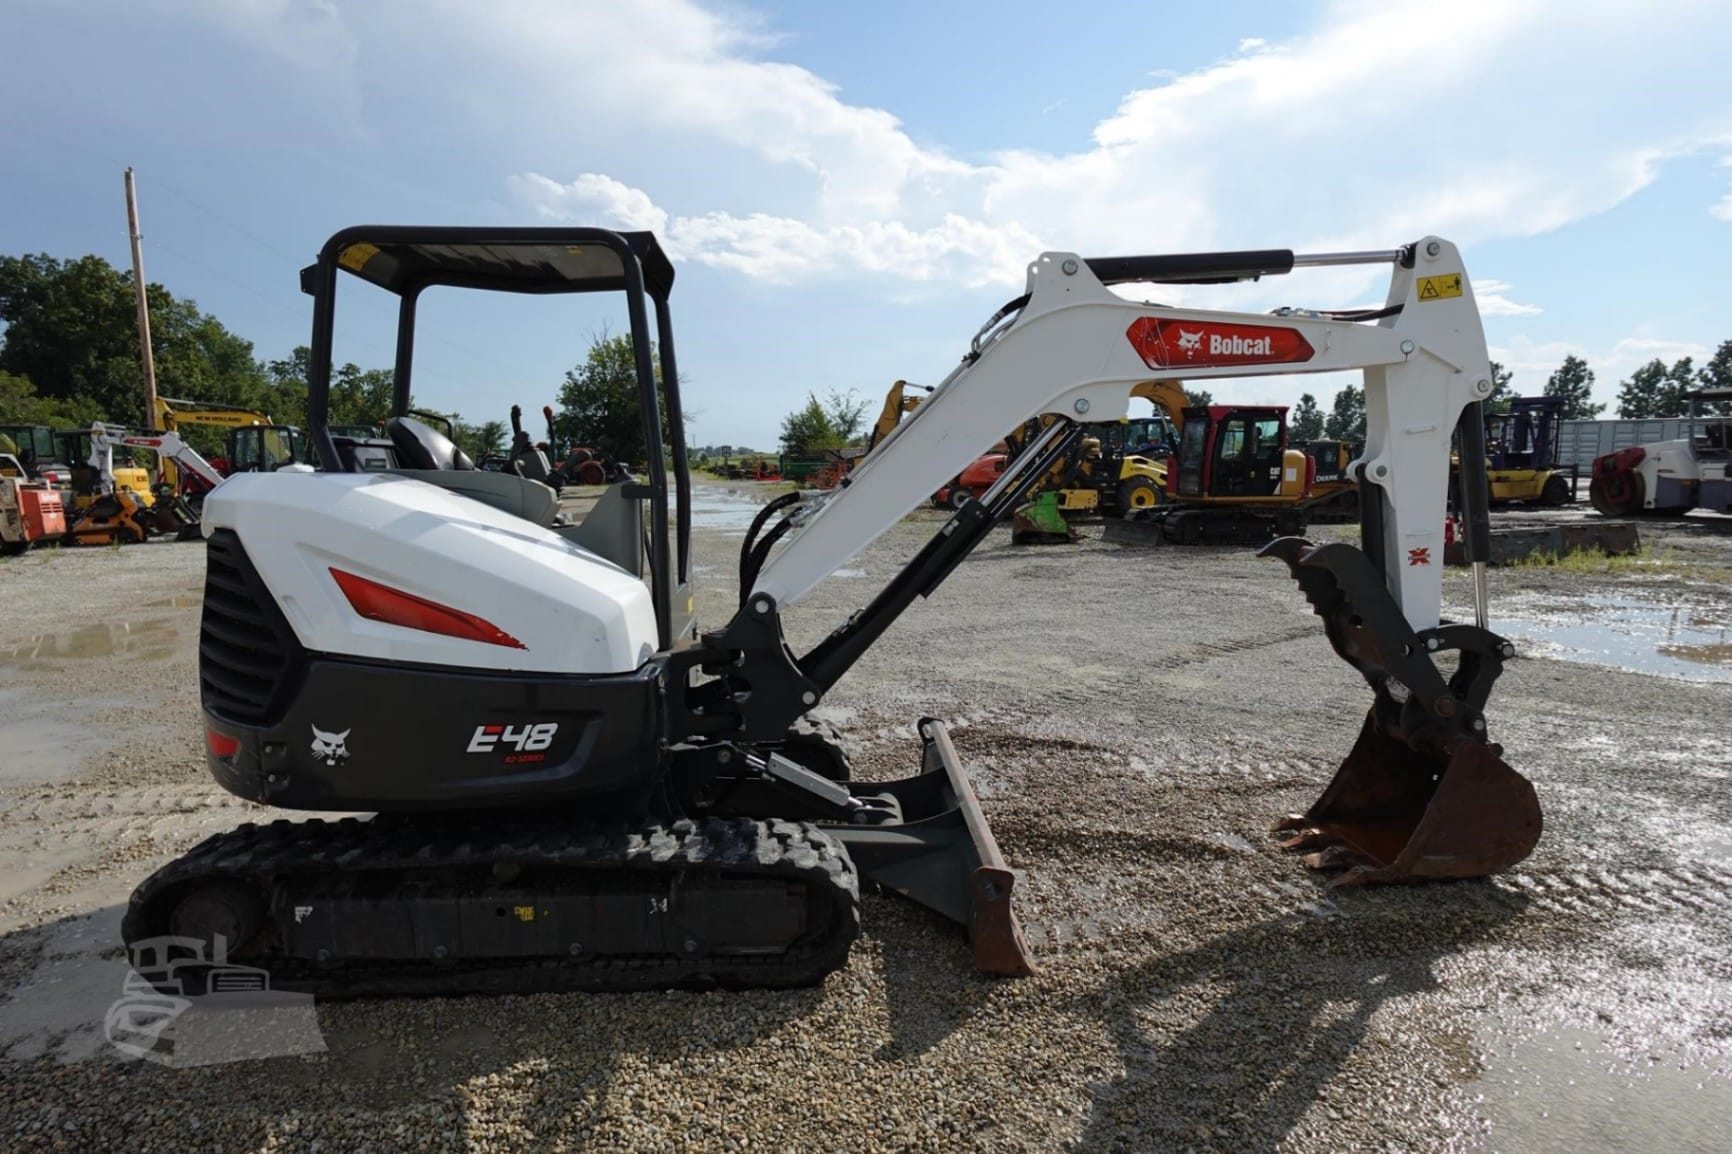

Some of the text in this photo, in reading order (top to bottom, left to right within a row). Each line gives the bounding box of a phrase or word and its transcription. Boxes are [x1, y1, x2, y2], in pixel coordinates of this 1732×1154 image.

[1210, 333, 1271, 355] Bobcat
[211, 415, 242, 423] HOLLAND
[466, 722, 558, 752] E48
